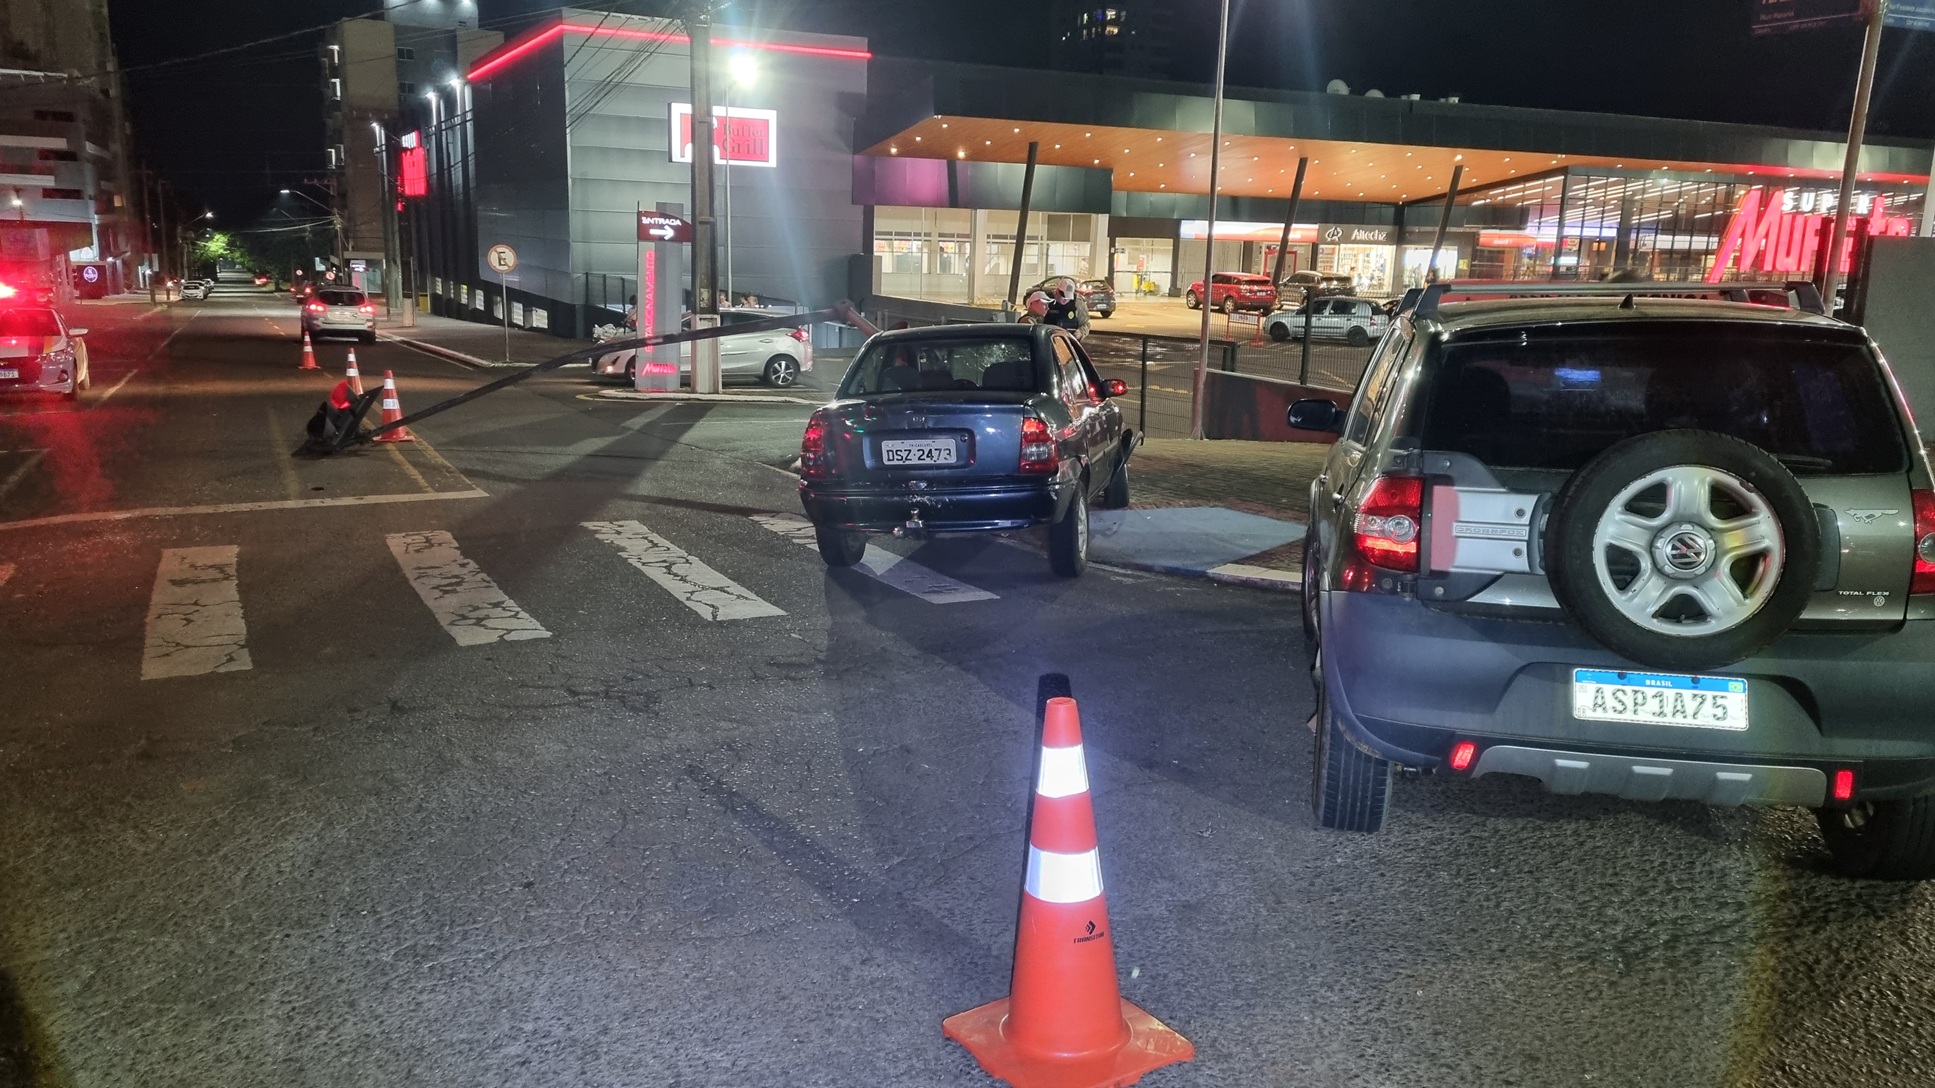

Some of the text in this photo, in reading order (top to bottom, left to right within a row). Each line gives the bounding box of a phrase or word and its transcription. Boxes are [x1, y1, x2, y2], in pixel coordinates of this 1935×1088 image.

[722, 137, 765, 155] Grill
[1781, 191, 1870, 214] SUPR
[641, 216, 682, 226] ENTRADA
[644, 250, 656, 353] ETACIONAMENTO
[1645, 679, 1673, 687] BRASIL
[1592, 686, 1729, 722] ASP1A75
